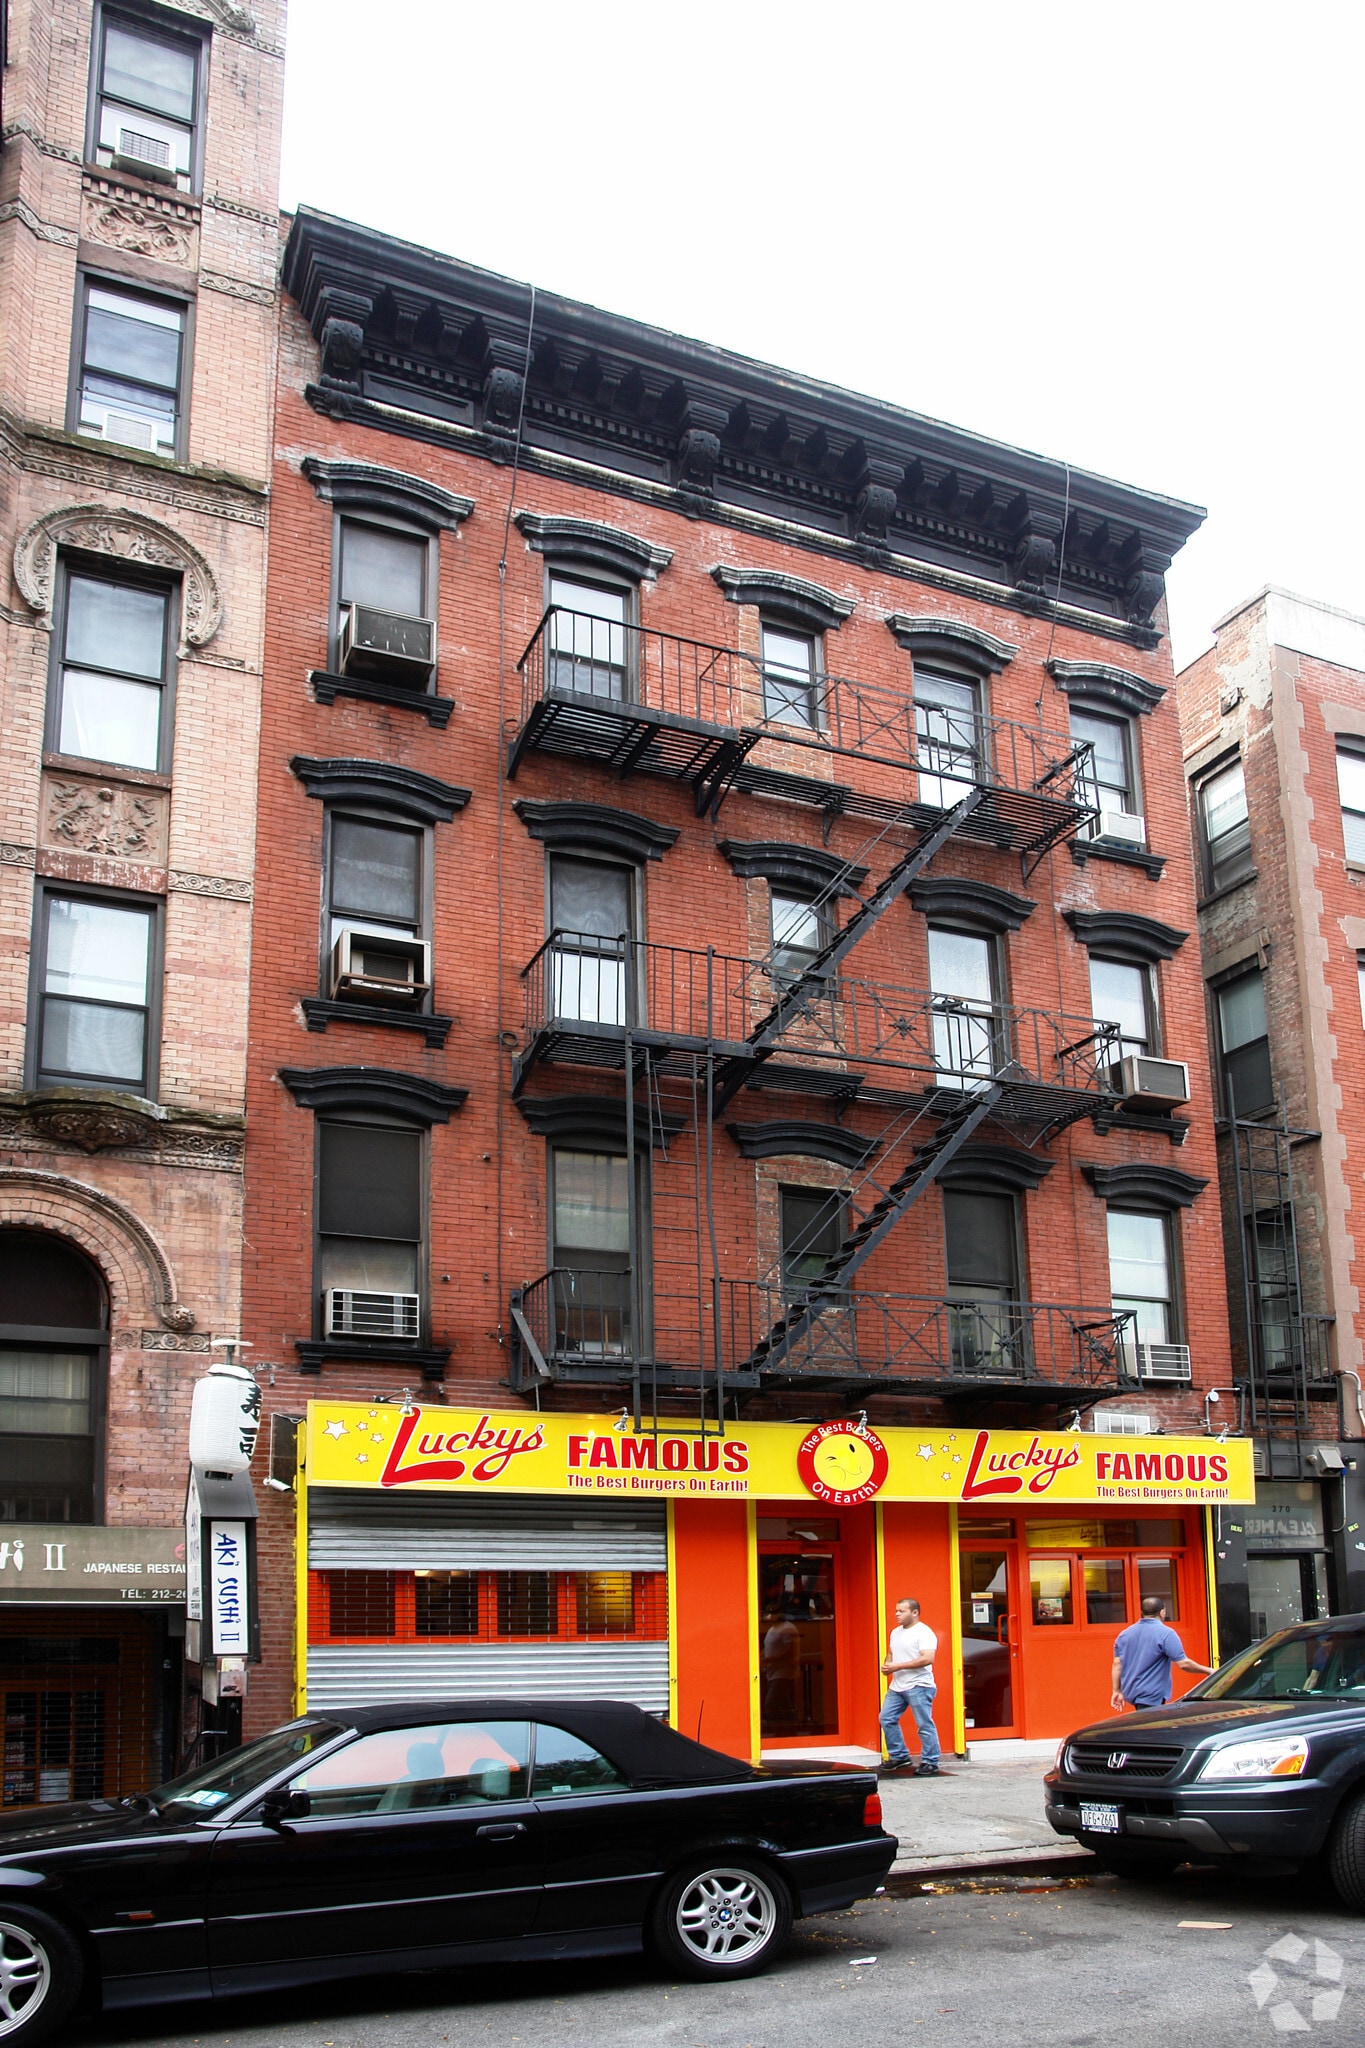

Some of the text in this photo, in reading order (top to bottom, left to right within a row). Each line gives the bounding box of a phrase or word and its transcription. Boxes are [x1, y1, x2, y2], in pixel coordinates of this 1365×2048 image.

[801, 1422, 883, 1453] The Best Bgers
[568, 1435, 749, 1473] FAMOUS
[1096, 1452, 1228, 1482] FAMOUS
[567, 1474, 748, 1491] The Best Burgers On Earth!
[812, 1480, 878, 1503] On Earth!
[1096, 1486, 1229, 1499] The Best Burgers On Earth!
[1271, 1505, 1291, 1513] 370
[83, 1563, 142, 1574] JAPANESE
[120, 1589, 146, 1599] TEL:
